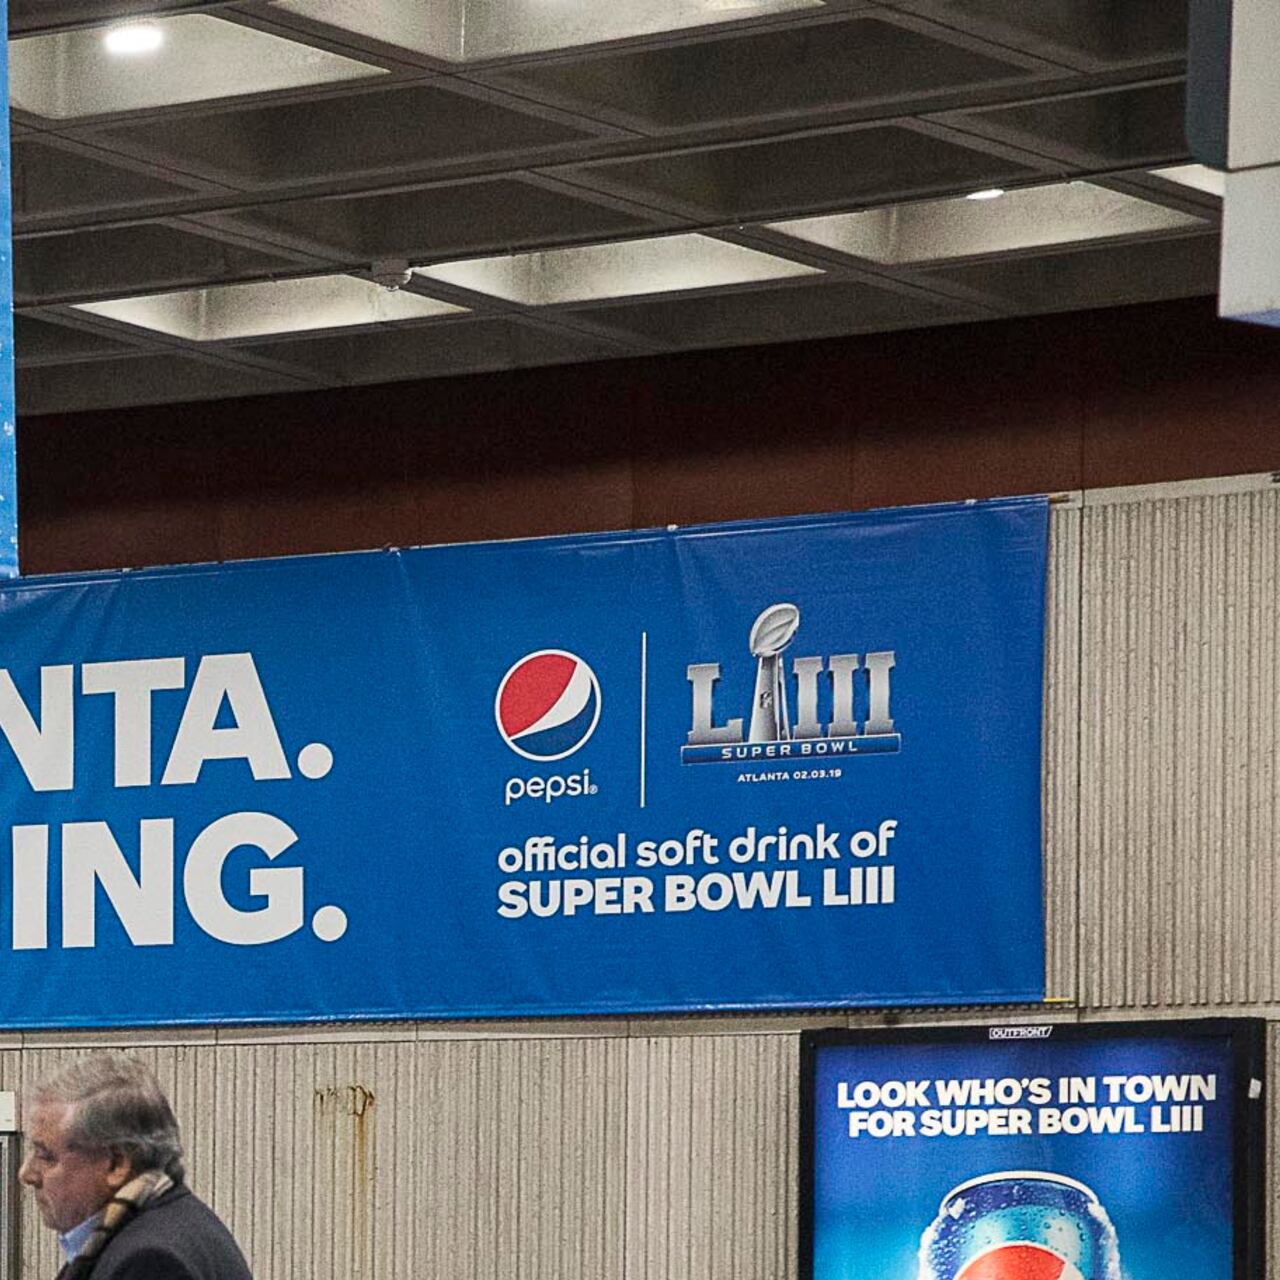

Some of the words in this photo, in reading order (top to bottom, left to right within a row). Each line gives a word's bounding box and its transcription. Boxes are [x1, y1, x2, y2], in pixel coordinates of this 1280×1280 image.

[720, 743, 792, 760] SUPER
[799, 739, 859, 756] BOWL
[736, 770, 790, 783] ATLANTA
[792, 768, 842, 780] 02.03.19
[496, 832, 627, 873] official
[635, 828, 719, 868] soft
[728, 822, 840, 863] drink
[849, 819, 899, 857] of
[496, 874, 656, 919] SUPER
[664, 869, 812, 913] BOWL
[823, 865, 896, 906] LIII
[836, 1078, 933, 1110] LOOK
[935, 1076, 1052, 1107] WHO'S
[1057, 1075, 1097, 1104] IN
[1102, 1073, 1217, 1103] TOWN
[848, 1109, 918, 1138] FOR
[919, 1107, 1032, 1137] SUPER
[1038, 1105, 1145, 1135] BOWL
[1150, 1104, 1204, 1133] LIII
